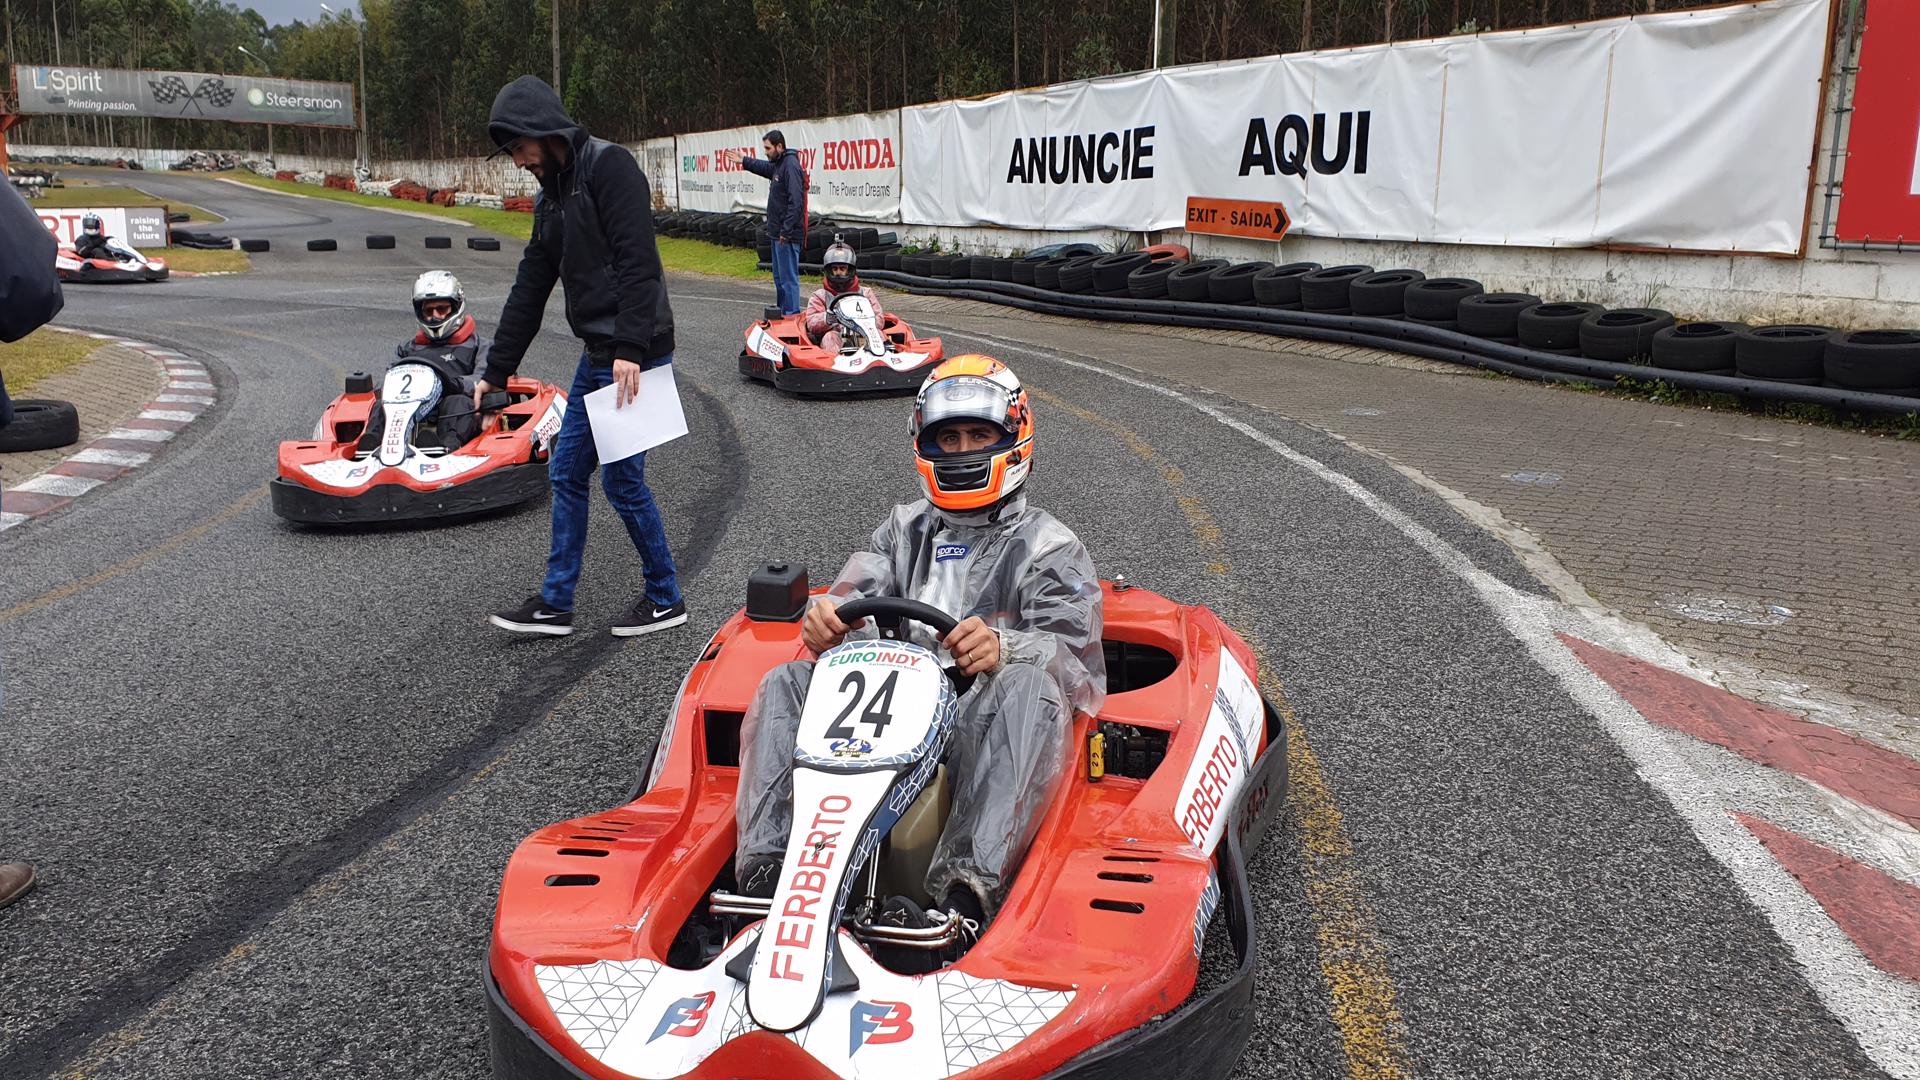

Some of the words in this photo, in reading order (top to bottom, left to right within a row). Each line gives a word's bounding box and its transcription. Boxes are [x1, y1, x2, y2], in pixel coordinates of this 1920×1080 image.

[68, 98, 101, 111] Printing
[103, 101, 137, 111] passion.
[266, 91, 342, 109] Steersman
[823, 138, 896, 171] HONDA
[1007, 125, 1156, 184] ANUNCIE
[1238, 110, 1371, 180] AQUI
[829, 181, 839, 195] The
[840, 182, 858, 196] Power
[865, 183, 890, 197] Dreams
[131, 217, 160, 228] raising
[1188, 207, 1218, 223] EXIT
[1231, 207, 1272, 229] SAÍDA
[133, 232, 160, 241] future
[856, 301, 863, 313] 4
[400, 373, 413, 395] 2
[937, 546, 966, 556] sparco
[828, 651, 922, 668] EUROINDY
[823, 670, 900, 738] 24
[769, 794, 852, 982] FERBERTO
